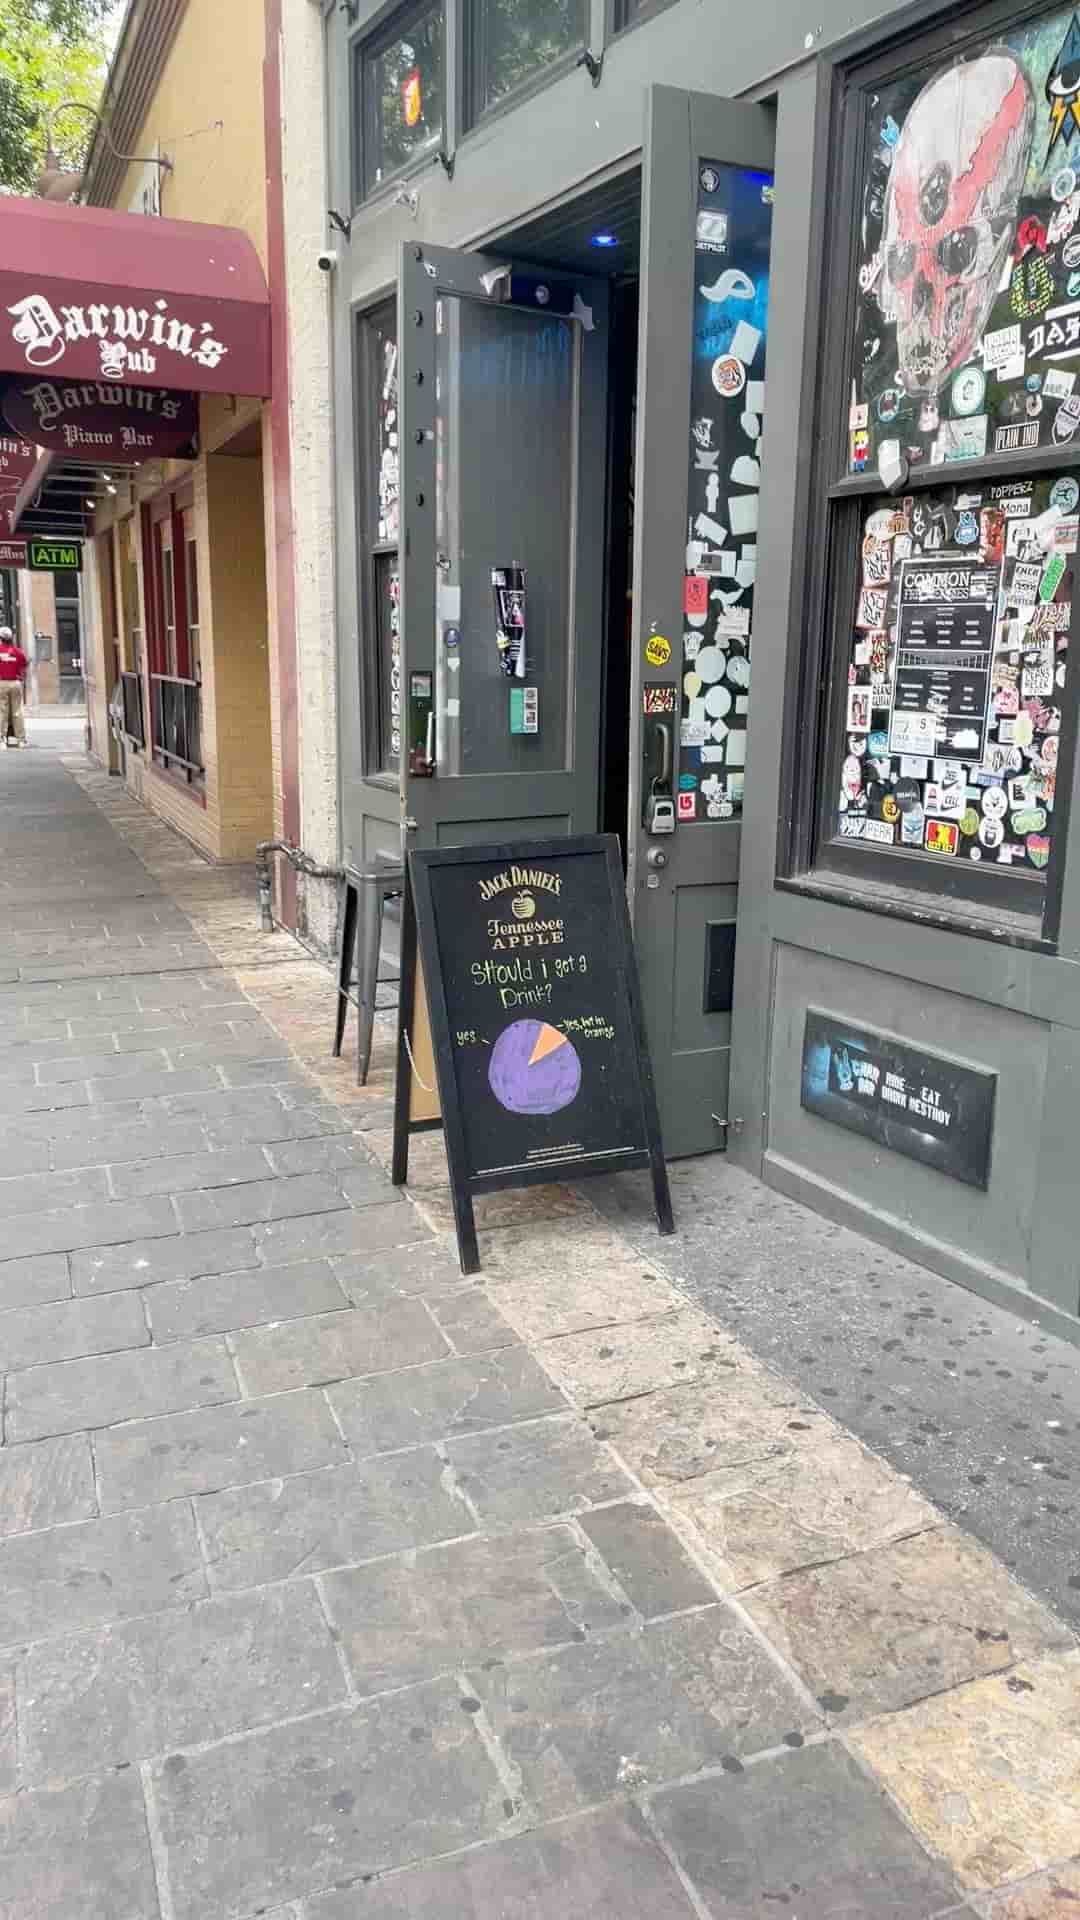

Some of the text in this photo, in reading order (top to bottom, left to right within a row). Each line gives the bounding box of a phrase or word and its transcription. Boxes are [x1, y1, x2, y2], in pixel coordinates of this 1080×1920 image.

[7, 294, 229, 369] Darwin's
[99, 340, 156, 378] Pub
[24, 381, 182, 432] Darwin's
[62, 424, 154, 450] Piano Bar
[37, 548, 74, 563] ATM
[479, 871, 513, 901] JACK
[488, 919, 564, 936] Tennessee
[492, 932, 564, 950] APPLE
[455, 1030, 477, 1046] yes
[881, 1085, 952, 1127] DRINK DESTROY
[921, 1086, 942, 1106] EAT
